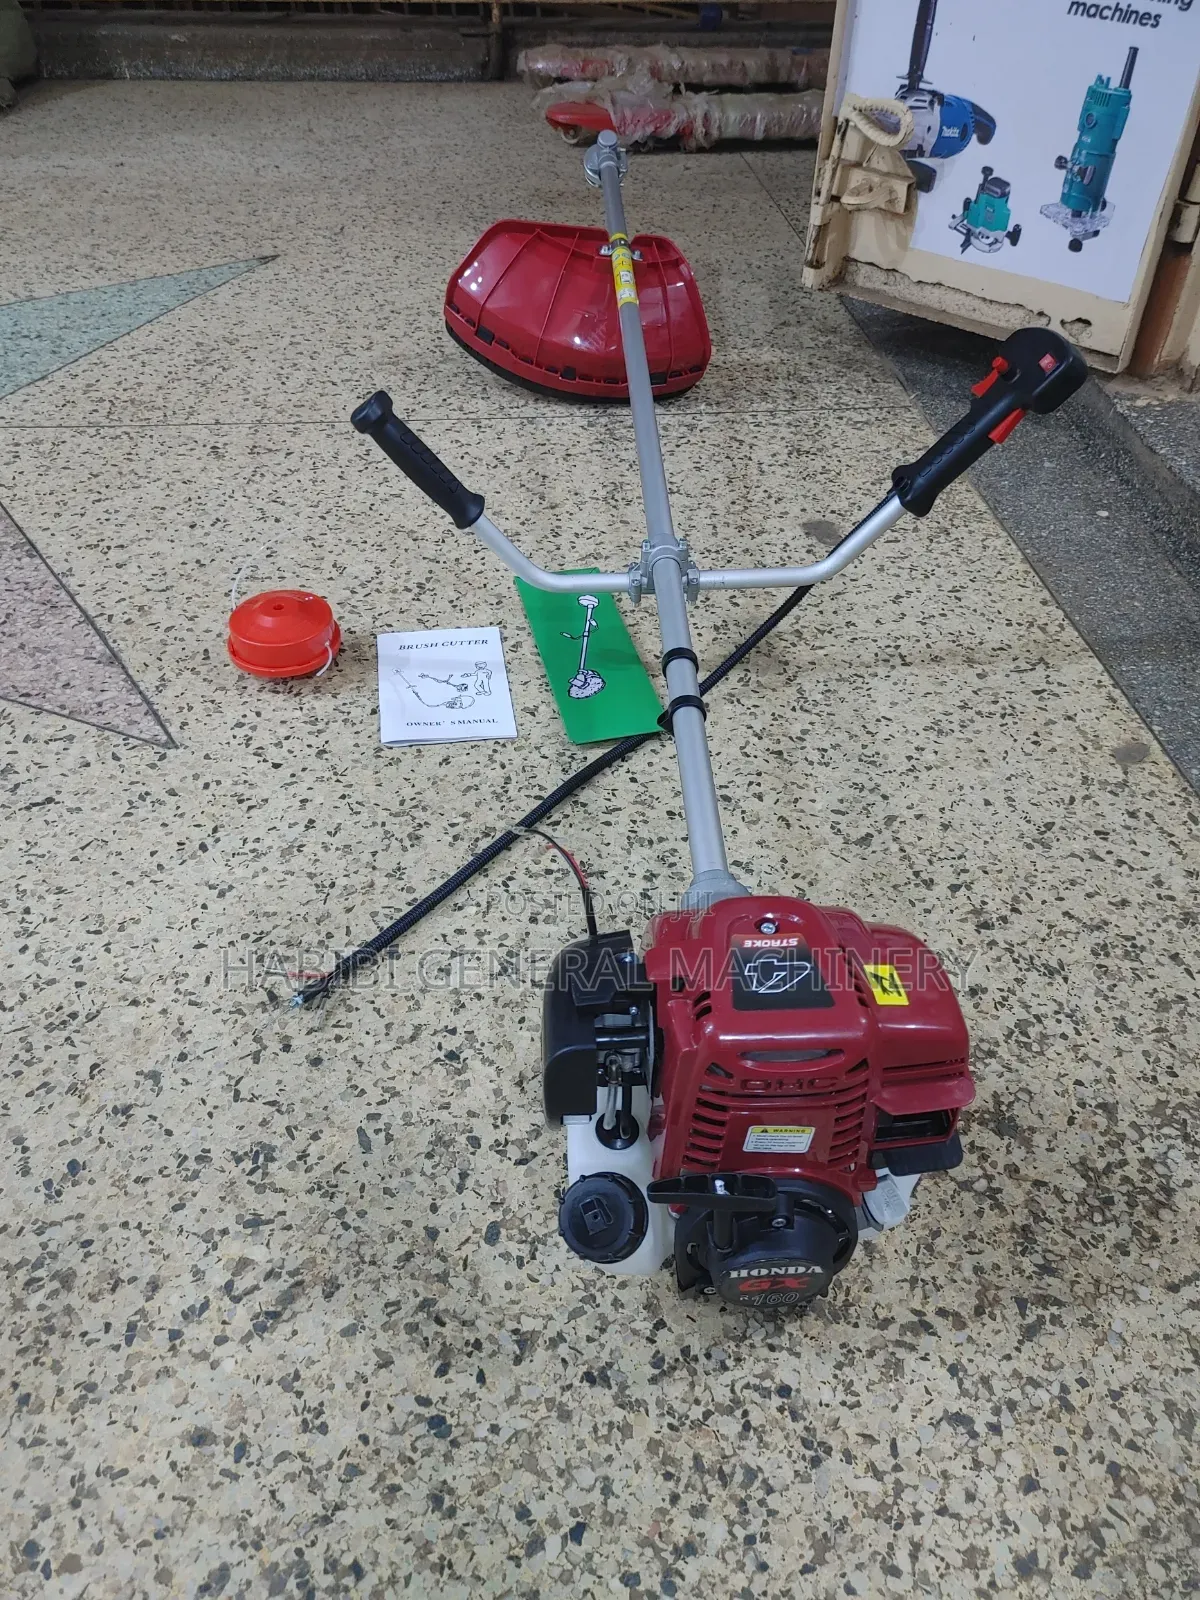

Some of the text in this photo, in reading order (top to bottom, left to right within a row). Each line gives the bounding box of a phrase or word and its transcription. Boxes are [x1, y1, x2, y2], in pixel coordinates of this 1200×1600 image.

[1067, 0, 1162, 28] machines
[398, 639, 488, 650] BRUSH CUTTER
[743, 938, 799, 948] STROKE
[741, 1077, 839, 1093] OHC
[729, 1266, 823, 1279] HONDA
[738, 1277, 809, 1292] GX
